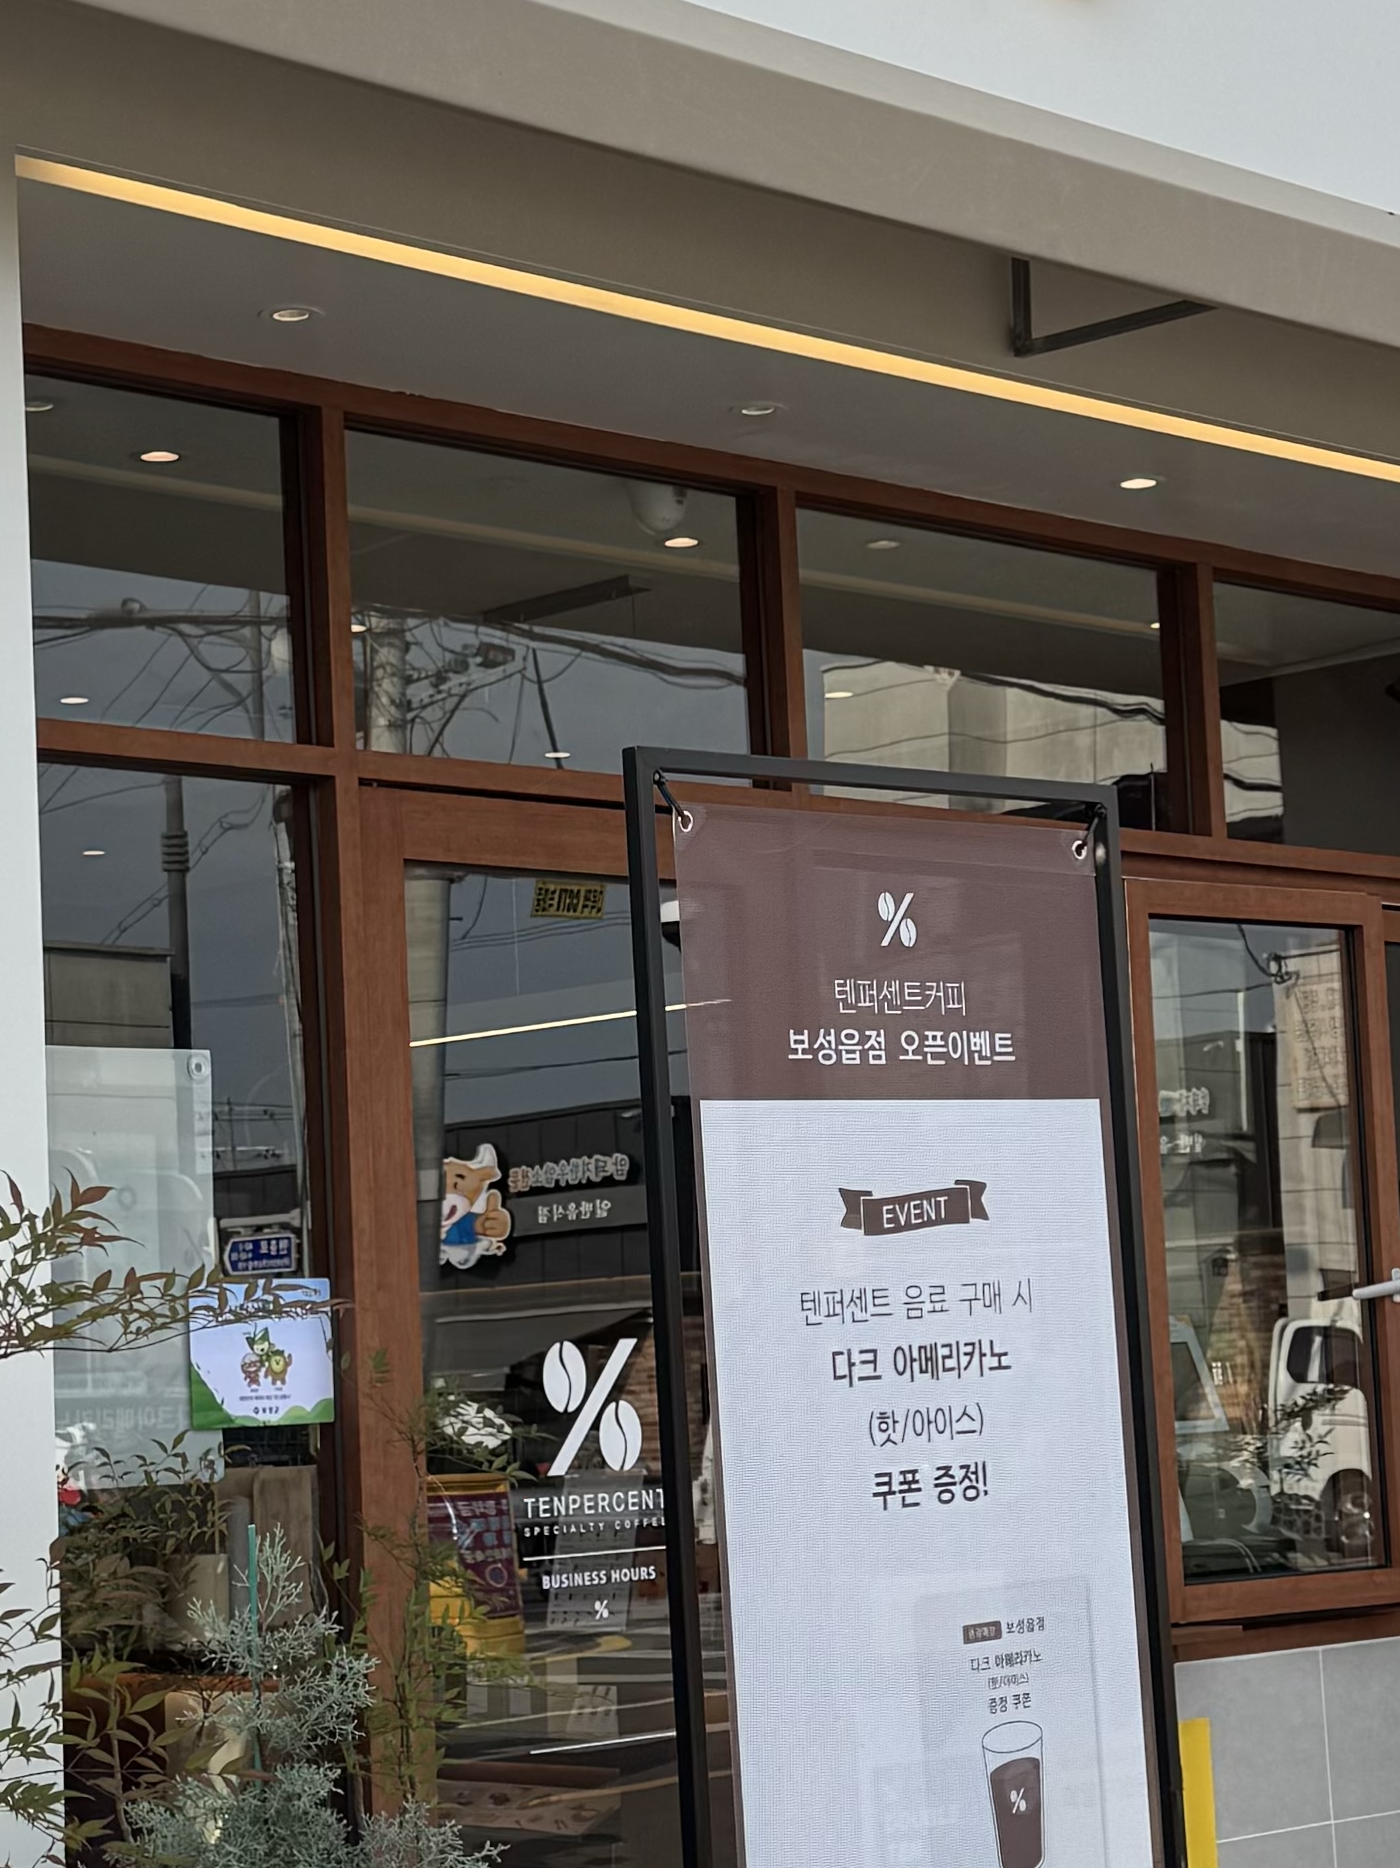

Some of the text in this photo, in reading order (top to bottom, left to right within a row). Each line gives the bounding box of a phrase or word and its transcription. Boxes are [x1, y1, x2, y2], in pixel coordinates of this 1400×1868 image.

[834, 978, 967, 1016] 텐퍼센트커피
[788, 1028, 1016, 1065] 보성읍점 오픈이벤트
[882, 1195, 949, 1229] EVENT
[800, 1278, 1033, 1327] 텐퍼센트 음료 구매 시
[831, 1338, 1012, 1388] 다크 아메리카노
[869, 1402, 984, 1447] (핫/아이스)
[523, 1488, 666, 1520] TENPERCENT
[872, 1460, 989, 1511] 쿠폰 증정!
[523, 1521, 605, 1537] SPECIALTY
[541, 1564, 656, 1591] BUSINESS HOURS
[970, 1656, 991, 1672] 다크
